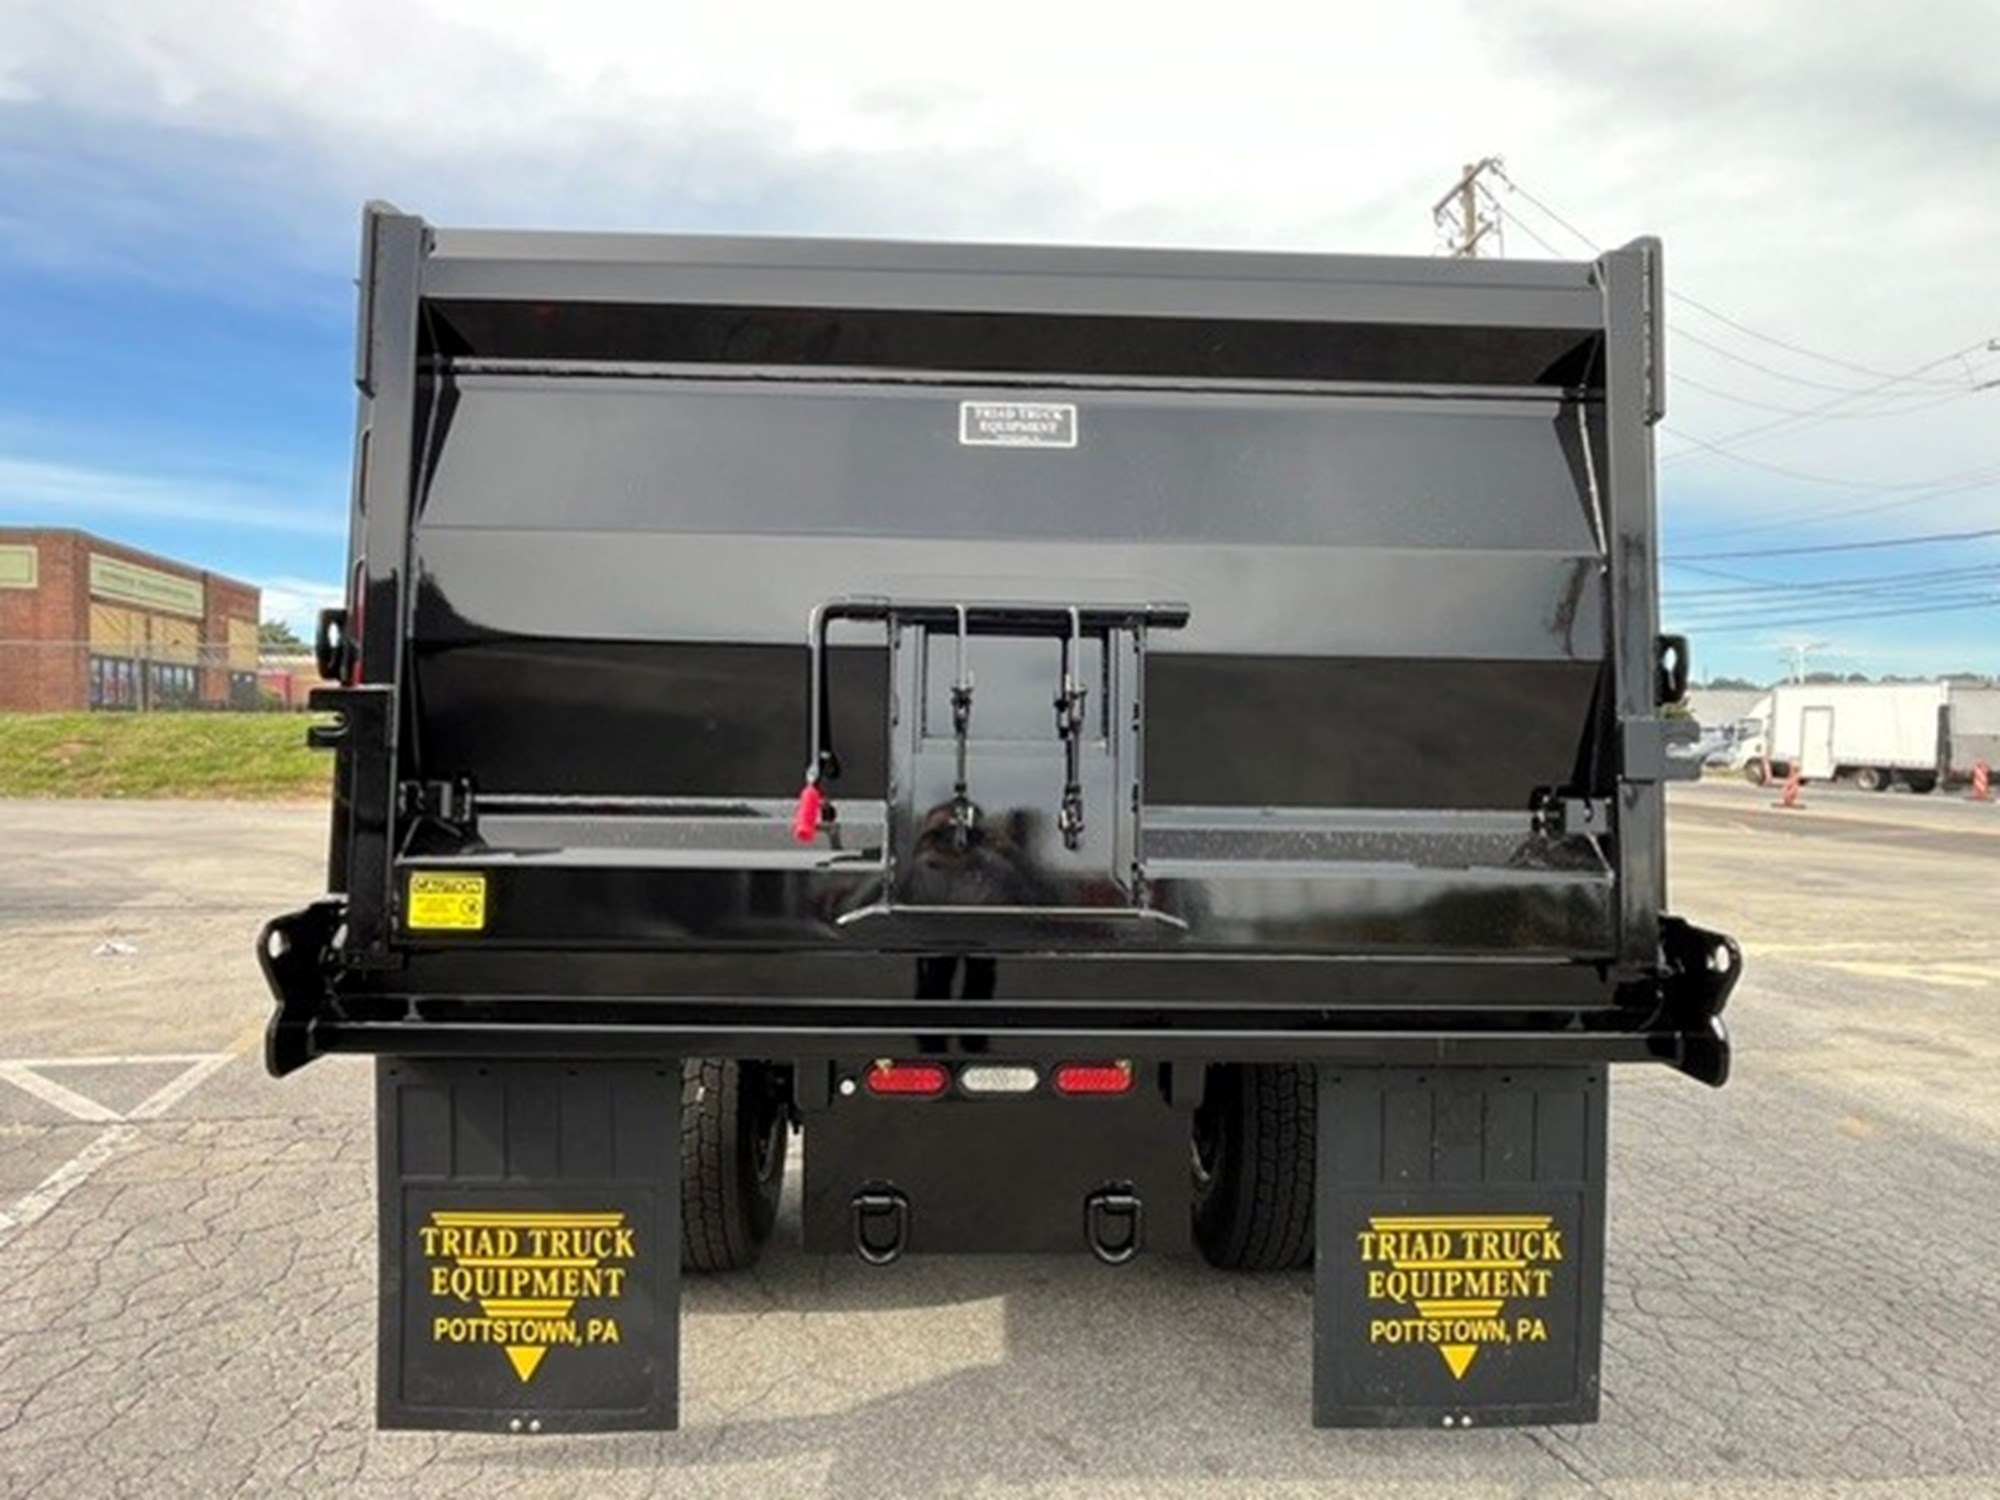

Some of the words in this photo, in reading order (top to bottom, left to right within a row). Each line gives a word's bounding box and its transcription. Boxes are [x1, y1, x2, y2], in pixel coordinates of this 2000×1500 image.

[419, 1227, 519, 1257] TRIAD
[527, 1228, 636, 1258] TRUCK
[1357, 1231, 1451, 1261] TRIAD
[1461, 1230, 1563, 1260] TRUCK
[431, 1266, 626, 1301] EQUIPMENT
[1368, 1269, 1553, 1304] EQUIPMENT
[433, 1317, 583, 1347] POTTSTOWN,
[586, 1318, 620, 1343] PA
[1370, 1319, 1512, 1345] POTTSTOWN,
[1516, 1318, 1547, 1341] PA
